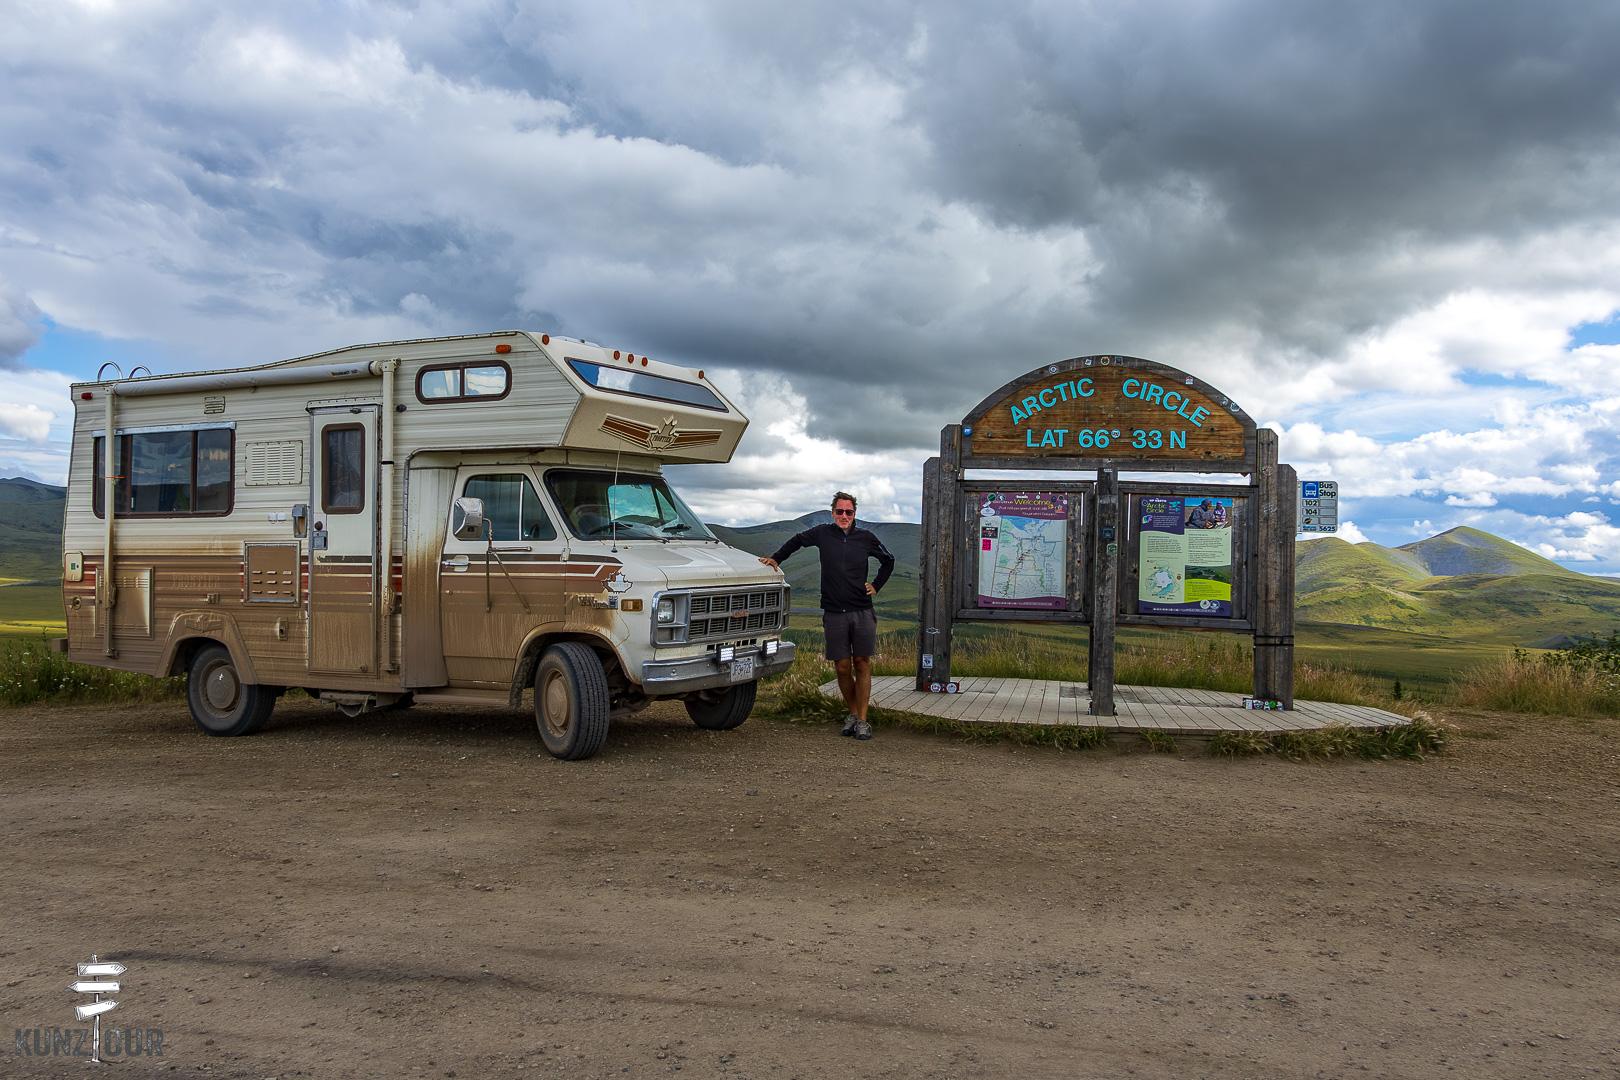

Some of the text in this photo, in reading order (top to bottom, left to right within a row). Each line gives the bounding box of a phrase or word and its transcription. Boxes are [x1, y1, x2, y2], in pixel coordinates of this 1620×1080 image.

[1010, 377, 1211, 427] ARCTIC CIRCLE
[1026, 429, 1068, 448] LAT
[1132, 430, 1163, 449] 33
[1169, 431, 1186, 449] N
[1319, 481, 1333, 489] Bus
[1319, 489, 1337, 498] Stop
